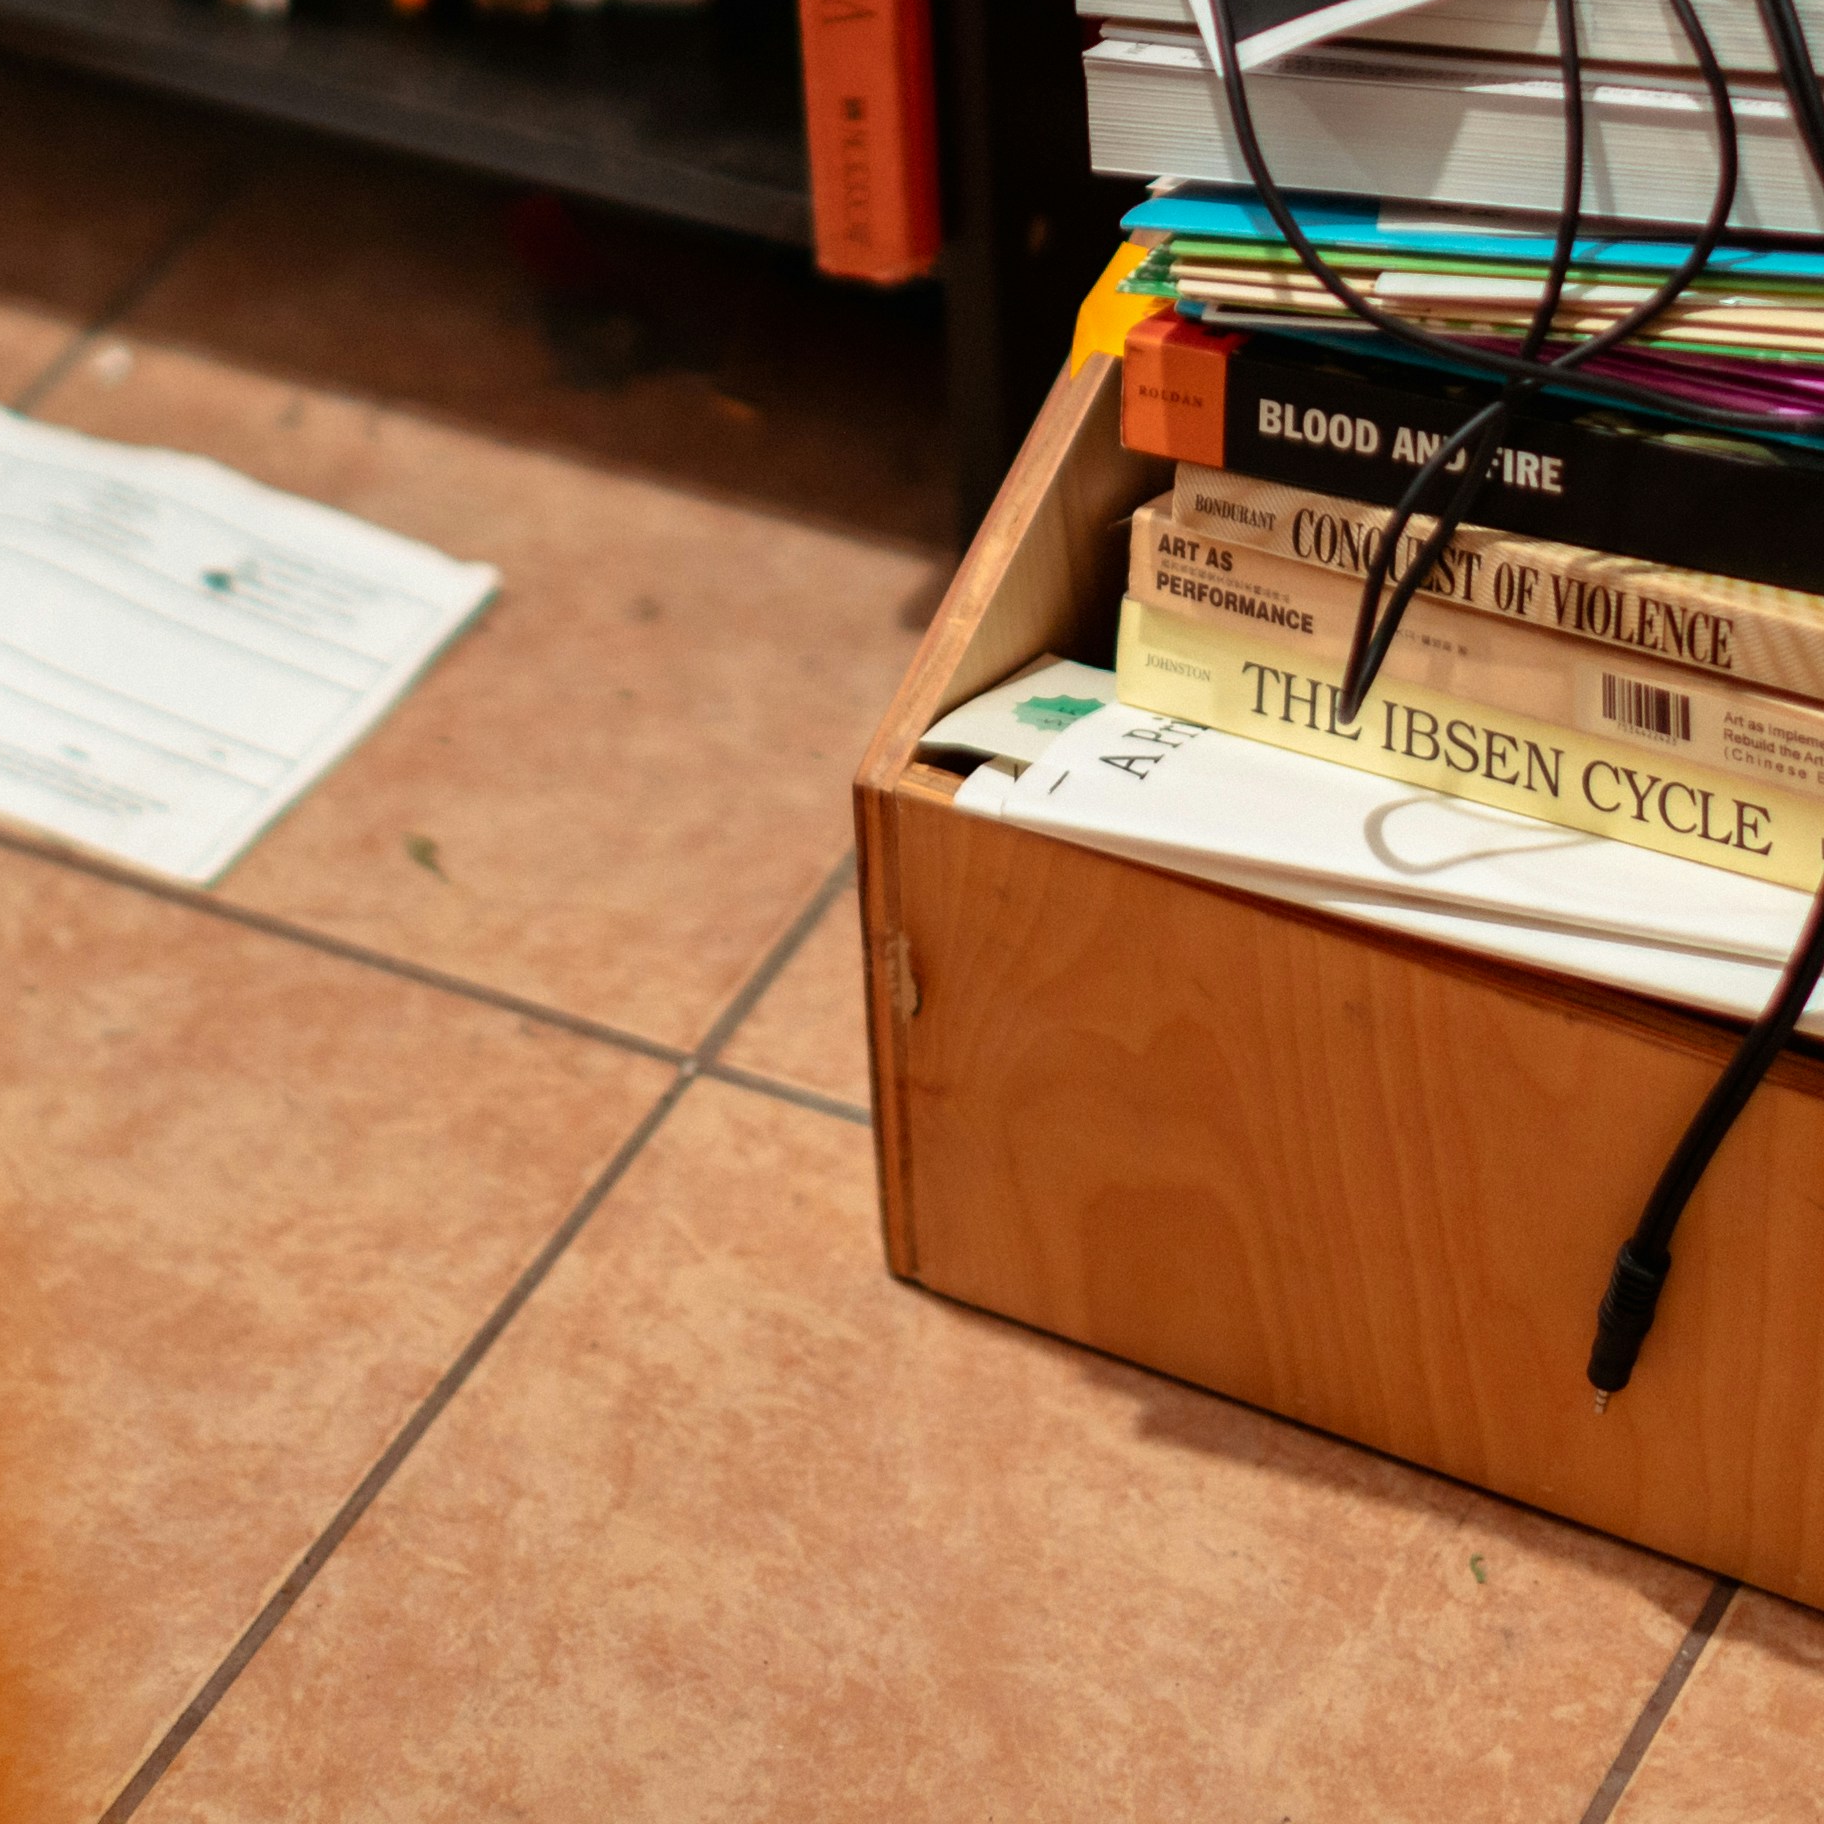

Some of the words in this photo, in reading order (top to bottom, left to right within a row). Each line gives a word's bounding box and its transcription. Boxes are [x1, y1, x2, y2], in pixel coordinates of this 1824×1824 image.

[1257, 397, 1378, 454] BLOOD
[1194, 493, 1277, 532] BONDURANT
[1157, 532, 1200, 563] ART
[1205, 546, 1234, 573] AS
[1156, 570, 1315, 635] PERFORMANCE
[1493, 560, 1539, 617] OF
[1549, 573, 1734, 670] VIOLENCE
[1145, 652, 1212, 683] JOHNSTON
[1723, 711, 1744, 728] Art
[1748, 719, 1765, 734] as
[1098, 752, 1166, 782] A
[1242, 660, 1363, 741] THE
[1380, 701, 1564, 799] IBSEN
[1581, 759, 1774, 857] CYCLE
[1723, 727, 1776, 754] Rebuild
[1779, 744, 1801, 761] the
[1804, 751, 1824, 767] Art
[1723, 746, 1807, 780] (Chinese
